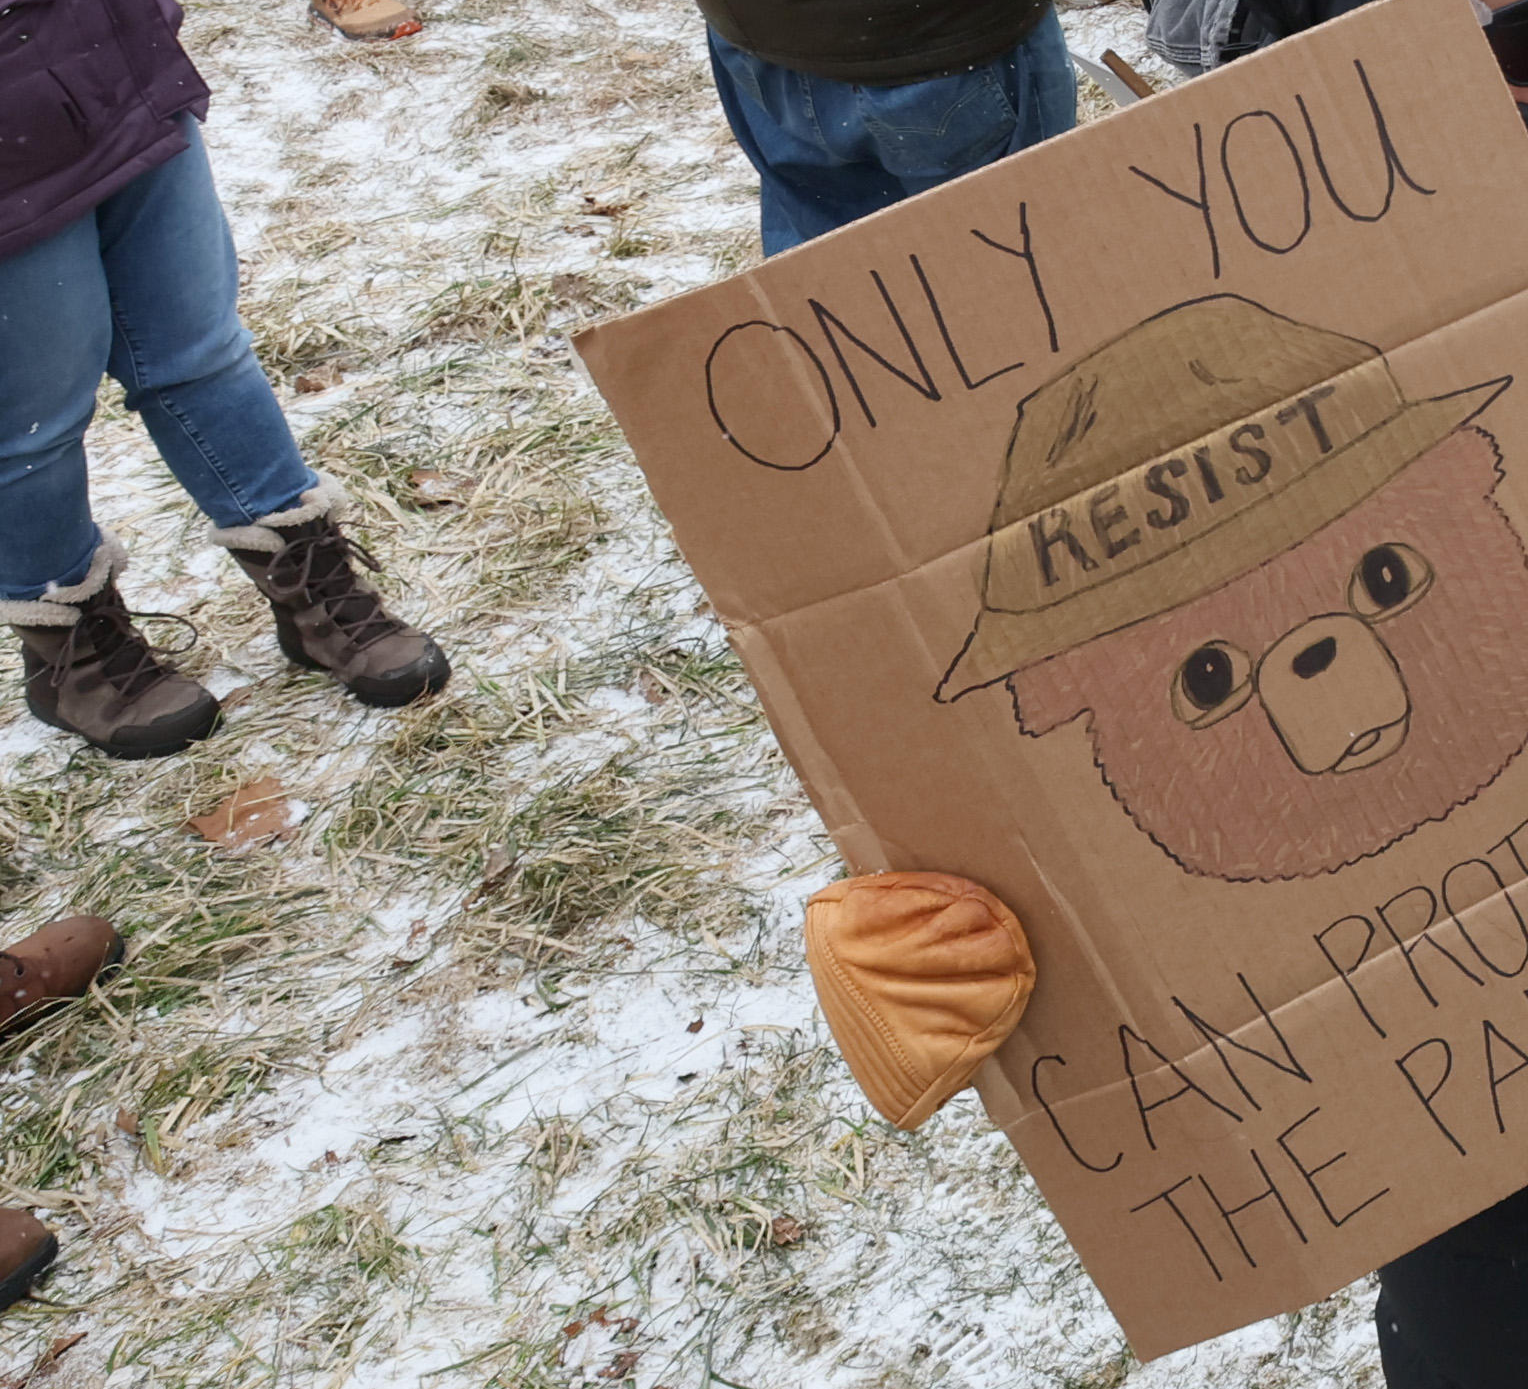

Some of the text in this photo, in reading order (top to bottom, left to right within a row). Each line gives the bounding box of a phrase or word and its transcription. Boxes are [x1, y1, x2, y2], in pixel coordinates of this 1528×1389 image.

[705, 59, 1438, 471] ONLY YOU
[1026, 383, 1342, 590] RESIST
[1031, 972, 1313, 1174] CAN
[1130, 1106, 1391, 1283] THE
